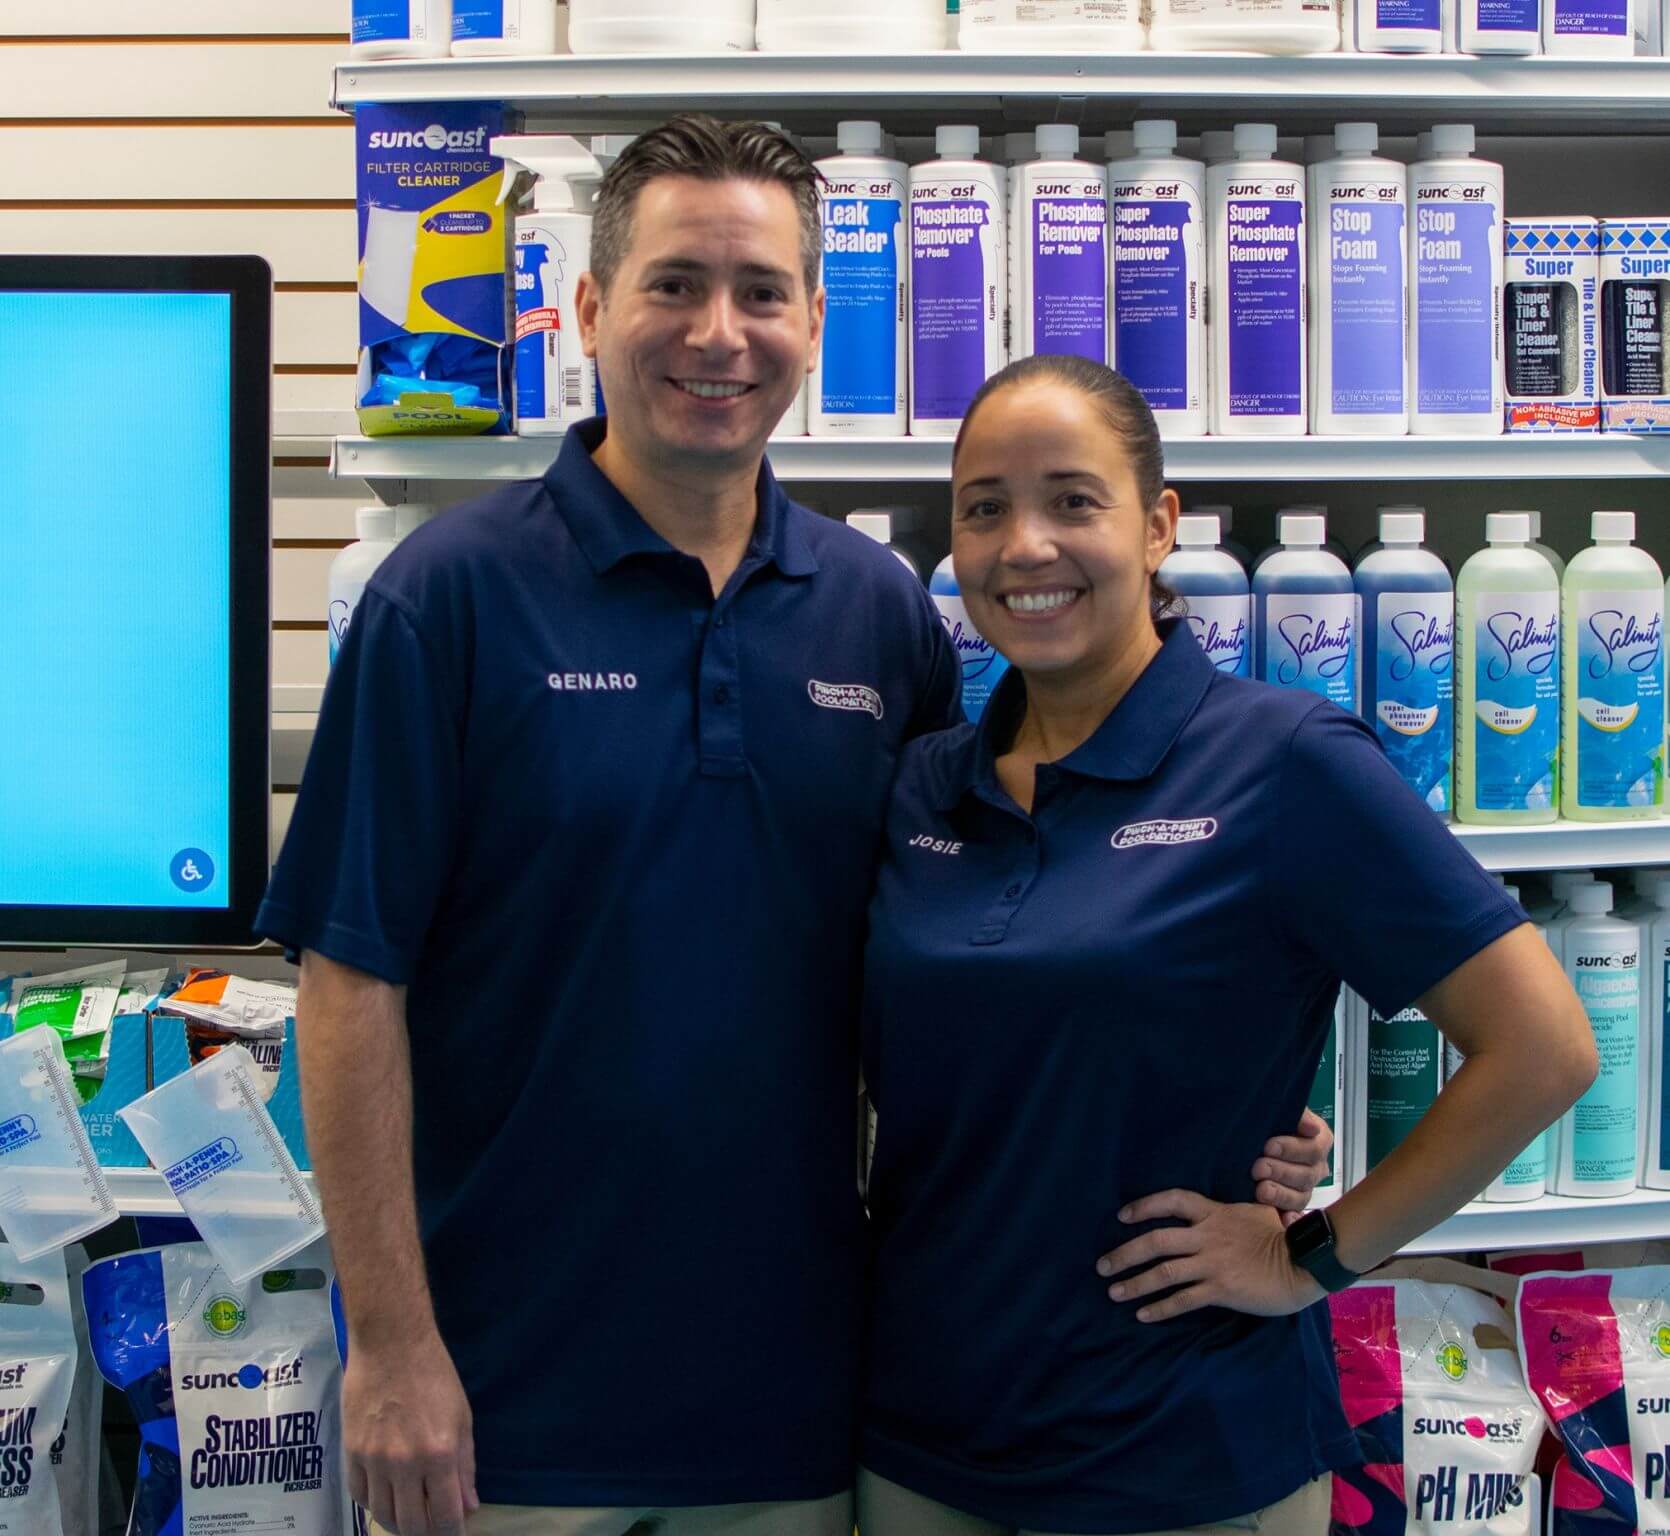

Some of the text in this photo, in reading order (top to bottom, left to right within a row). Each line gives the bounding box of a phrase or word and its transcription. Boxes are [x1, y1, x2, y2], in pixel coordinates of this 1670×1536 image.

[1555, 18, 1585, 26] DANGER
[366, 161, 491, 174] FILTER CARTRIDGE
[398, 176, 461, 187] CLEANER
[824, 200, 870, 226] Leak
[913, 205, 984, 227] Phosphate
[1038, 202, 1105, 224] Phosphate
[1115, 205, 1150, 225] Super
[1229, 204, 1271, 224] Super
[1332, 207, 1372, 235] Stop
[1418, 208, 1456, 235] Stop
[824, 226, 888, 253] Sealer
[914, 226, 974, 247] Remover
[1038, 223, 1101, 243] Remover
[1115, 224, 1179, 244] Phosphate
[1229, 224, 1296, 244] Phosphate
[914, 247, 950, 258] For Pools
[1039, 244, 1083, 255] For Pools
[1115, 245, 1170, 262] Remover
[1229, 245, 1289, 262] Remover
[1332, 236, 1377, 260] Foam
[1418, 236, 1461, 260] Foam
[1332, 264, 1387, 274] Stops Foaming
[1419, 264, 1472, 274] Stops Foaming
[1525, 257, 1574, 278] Super
[1621, 257, 1670, 277] Super
[1332, 275, 1365, 285] Instantly
[1419, 275, 1449, 285] Instantly
[897, 282, 905, 323] Specialty
[1189, 280, 1197, 320] Specialty
[1516, 291, 1550, 306] Super
[1516, 305, 1550, 318] Tile &
[1625, 302, 1656, 315] Tile &
[1516, 319, 1546, 333] Liner
[1625, 315, 1655, 329] Liner
[1516, 333, 1558, 347] Cleaner
[1583, 277, 1597, 398] Tile & Liner Cleaner
[1230, 399, 1260, 407] DANGER
[392, 411, 472, 421] POOL
[1515, 405, 1596, 418] NON-ABRASIVE PAD
[1534, 412, 1580, 425] INCLUDED!
[1278, 613, 1352, 685] Salinity
[1487, 611, 1558, 682] Salinity
[1589, 609, 1660, 680] Salinity
[548, 673, 638, 691] GENARO
[1383, 704, 1405, 712] super
[1494, 710, 1509, 718] cell
[1389, 712, 1427, 720] phosphate
[1596, 715, 1624, 723] cleaner
[909, 834, 964, 856] JOSIE
[1616, 1013, 1629, 1022] Pool
[1369, 1055, 1405, 1063] Destruction
[1393, 1048, 1416, 1056] Control
[1369, 1062, 1427, 1070] And Mustard Algae
[1384, 1069, 1401, 1078] Algal
[80, 1113, 121, 1124] WATER
[205, 1408, 323, 1453] STABILIZER/
[190, 1445, 323, 1490] CONDITIONER
[283, 1479, 322, 1493] INCREASER
[189, 1514, 210, 1522] ACTIVE
[216, 1520, 231, 1528] Acid
[231, 1519, 256, 1528] Hydrate
